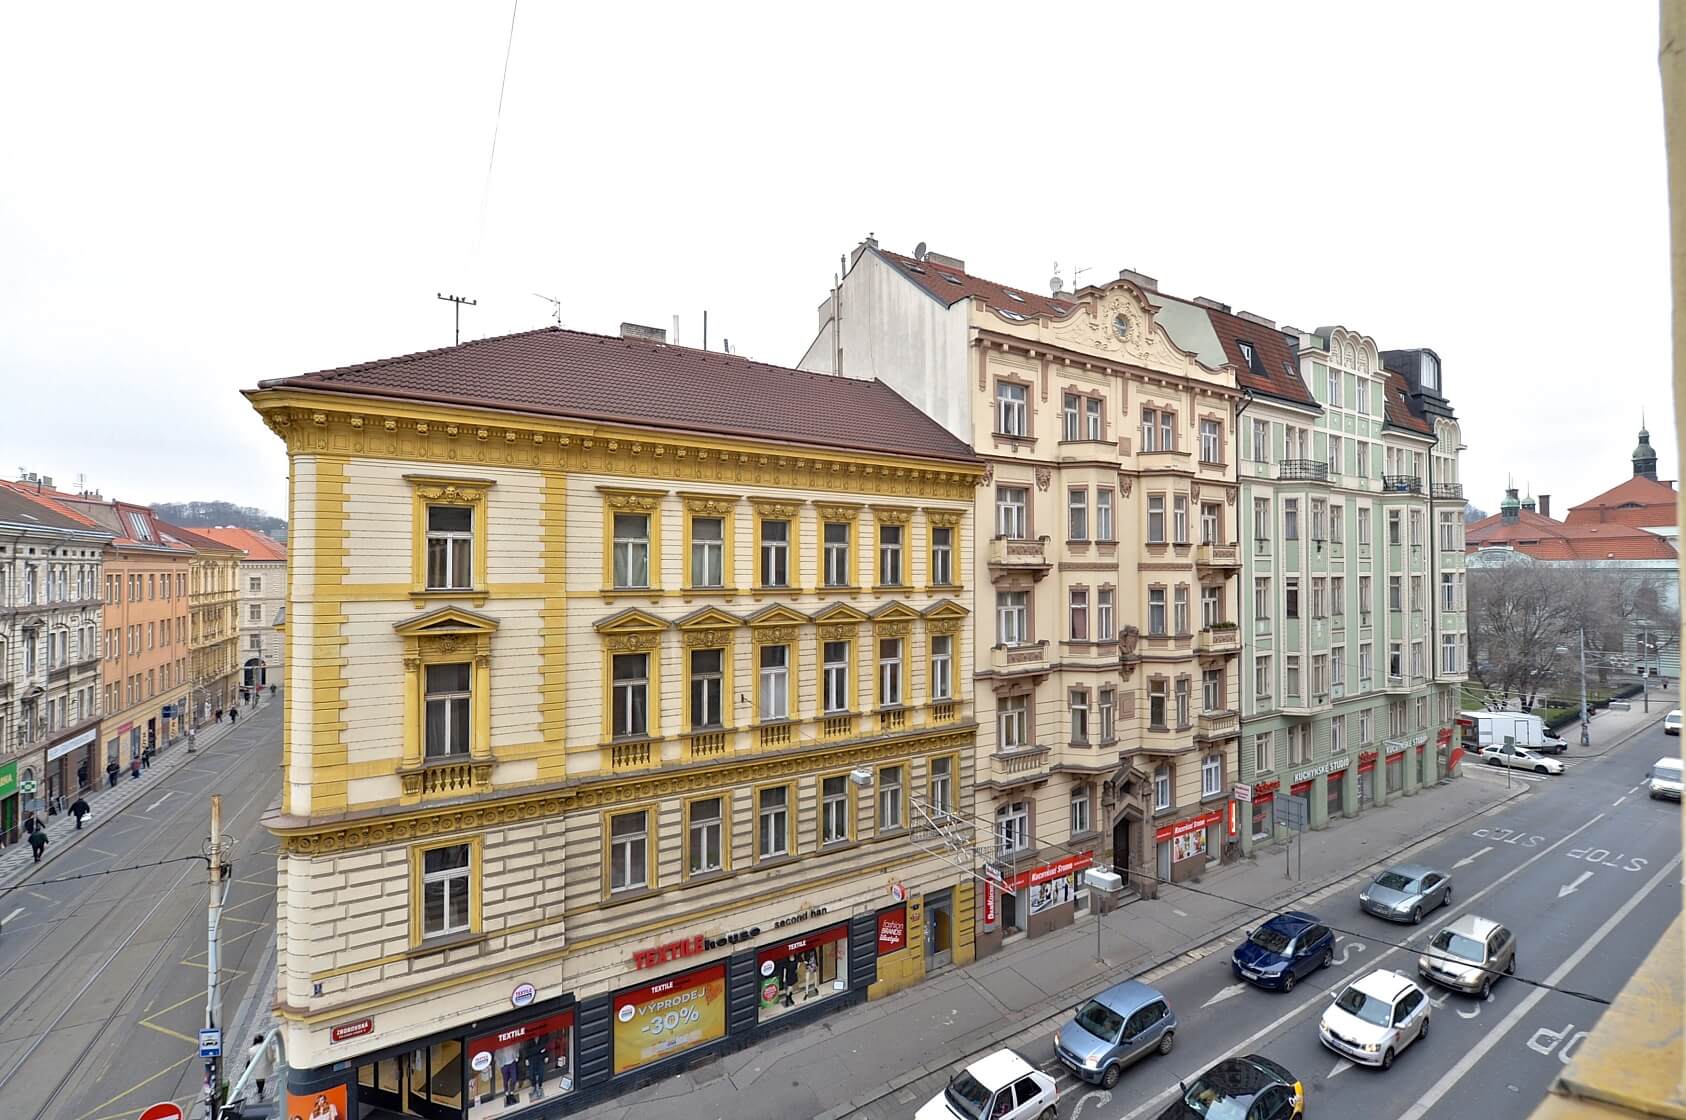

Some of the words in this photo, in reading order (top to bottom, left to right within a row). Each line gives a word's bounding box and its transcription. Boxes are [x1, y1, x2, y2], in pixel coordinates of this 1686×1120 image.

[1329, 756, 1349, 771] STUDIO
[1566, 847, 1648, 872] STOP
[774, 910, 808, 929] second
[633, 934, 705, 971] TEXTILE
[788, 939, 807, 951] TEXTILE
[651, 981, 674, 994] TEXTILE
[638, 985, 706, 1017] VÝPRODEJ
[641, 1004, 700, 1035] -30%
[498, 1027, 526, 1042] TEXTILE
